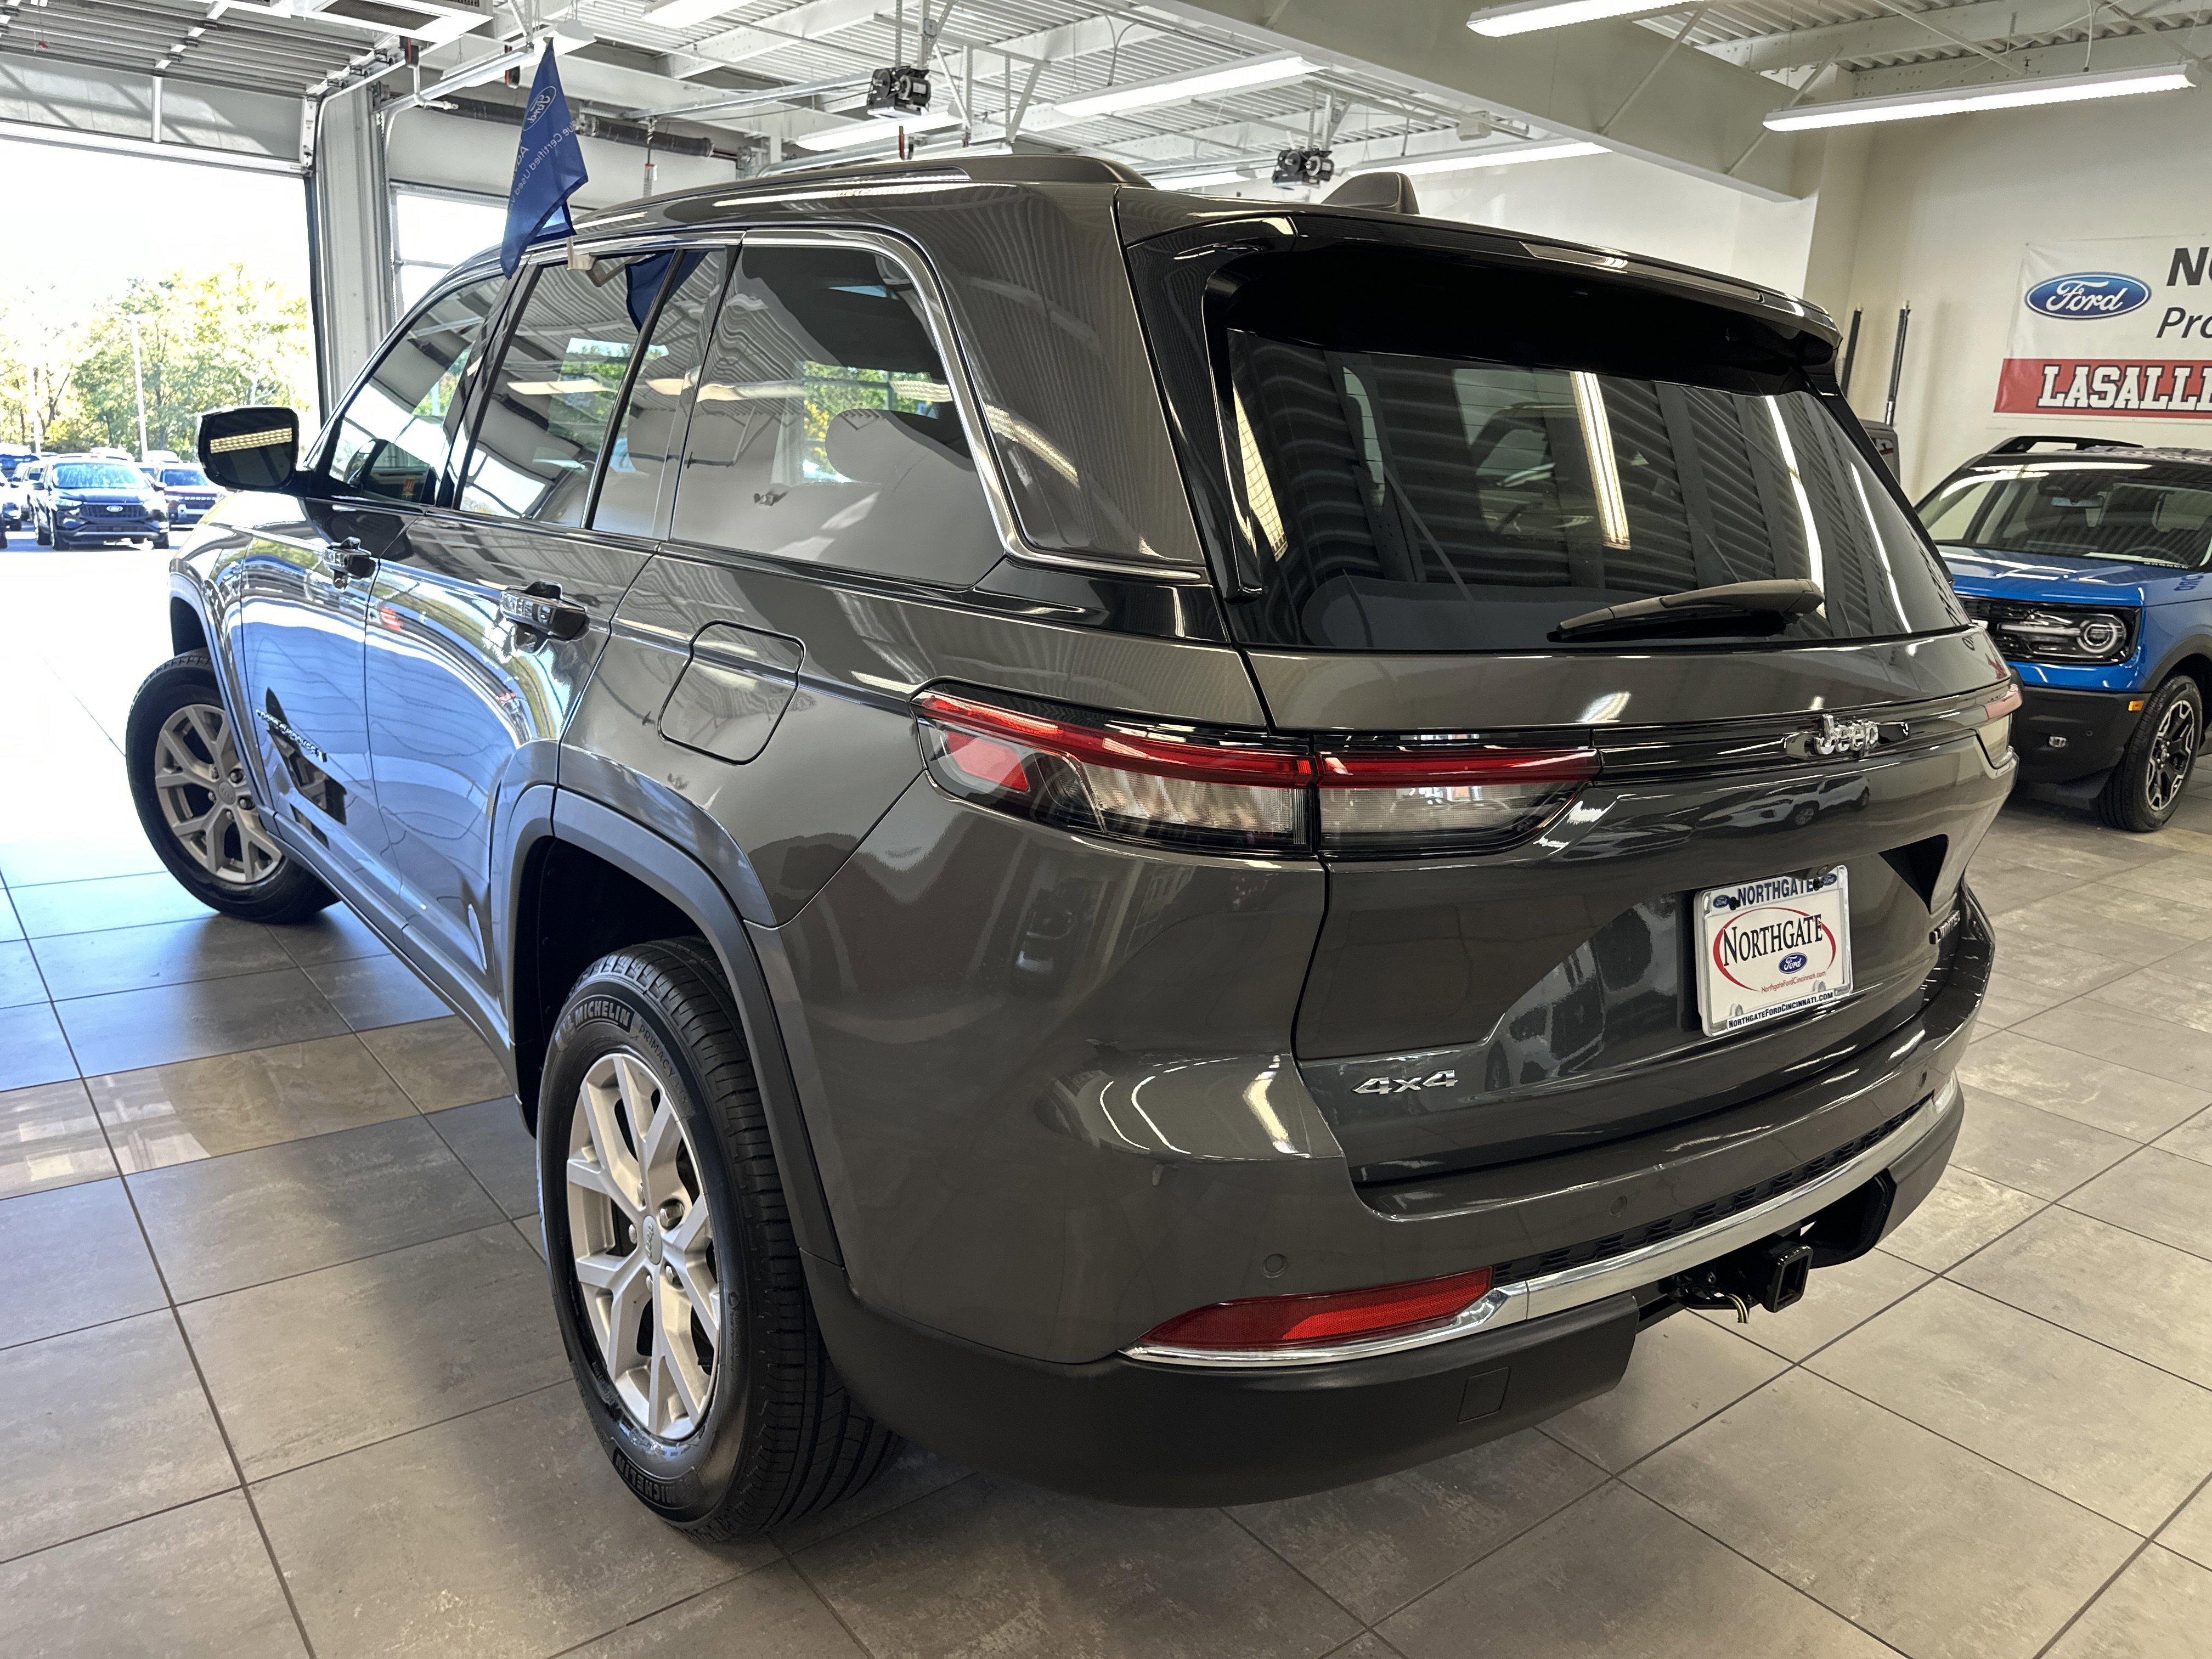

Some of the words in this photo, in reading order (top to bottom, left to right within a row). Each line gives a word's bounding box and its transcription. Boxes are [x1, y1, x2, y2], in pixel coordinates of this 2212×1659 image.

[2166, 247, 2212, 286] N
[2045, 280, 2129, 312] Ford
[1814, 714, 1878, 758] Jeep
[1738, 878, 1814, 906] NORTHGATE
[1723, 913, 1823, 967] NORTHGATE
[1784, 955, 1803, 970] Ford
[1760, 970, 1826, 993] NorthgateFordCincinnati.com
[575, 1000, 631, 1028] MICHELIN
[639, 1024, 676, 1077] PRIMACY
[614, 1453, 677, 1504] MICHELIN
